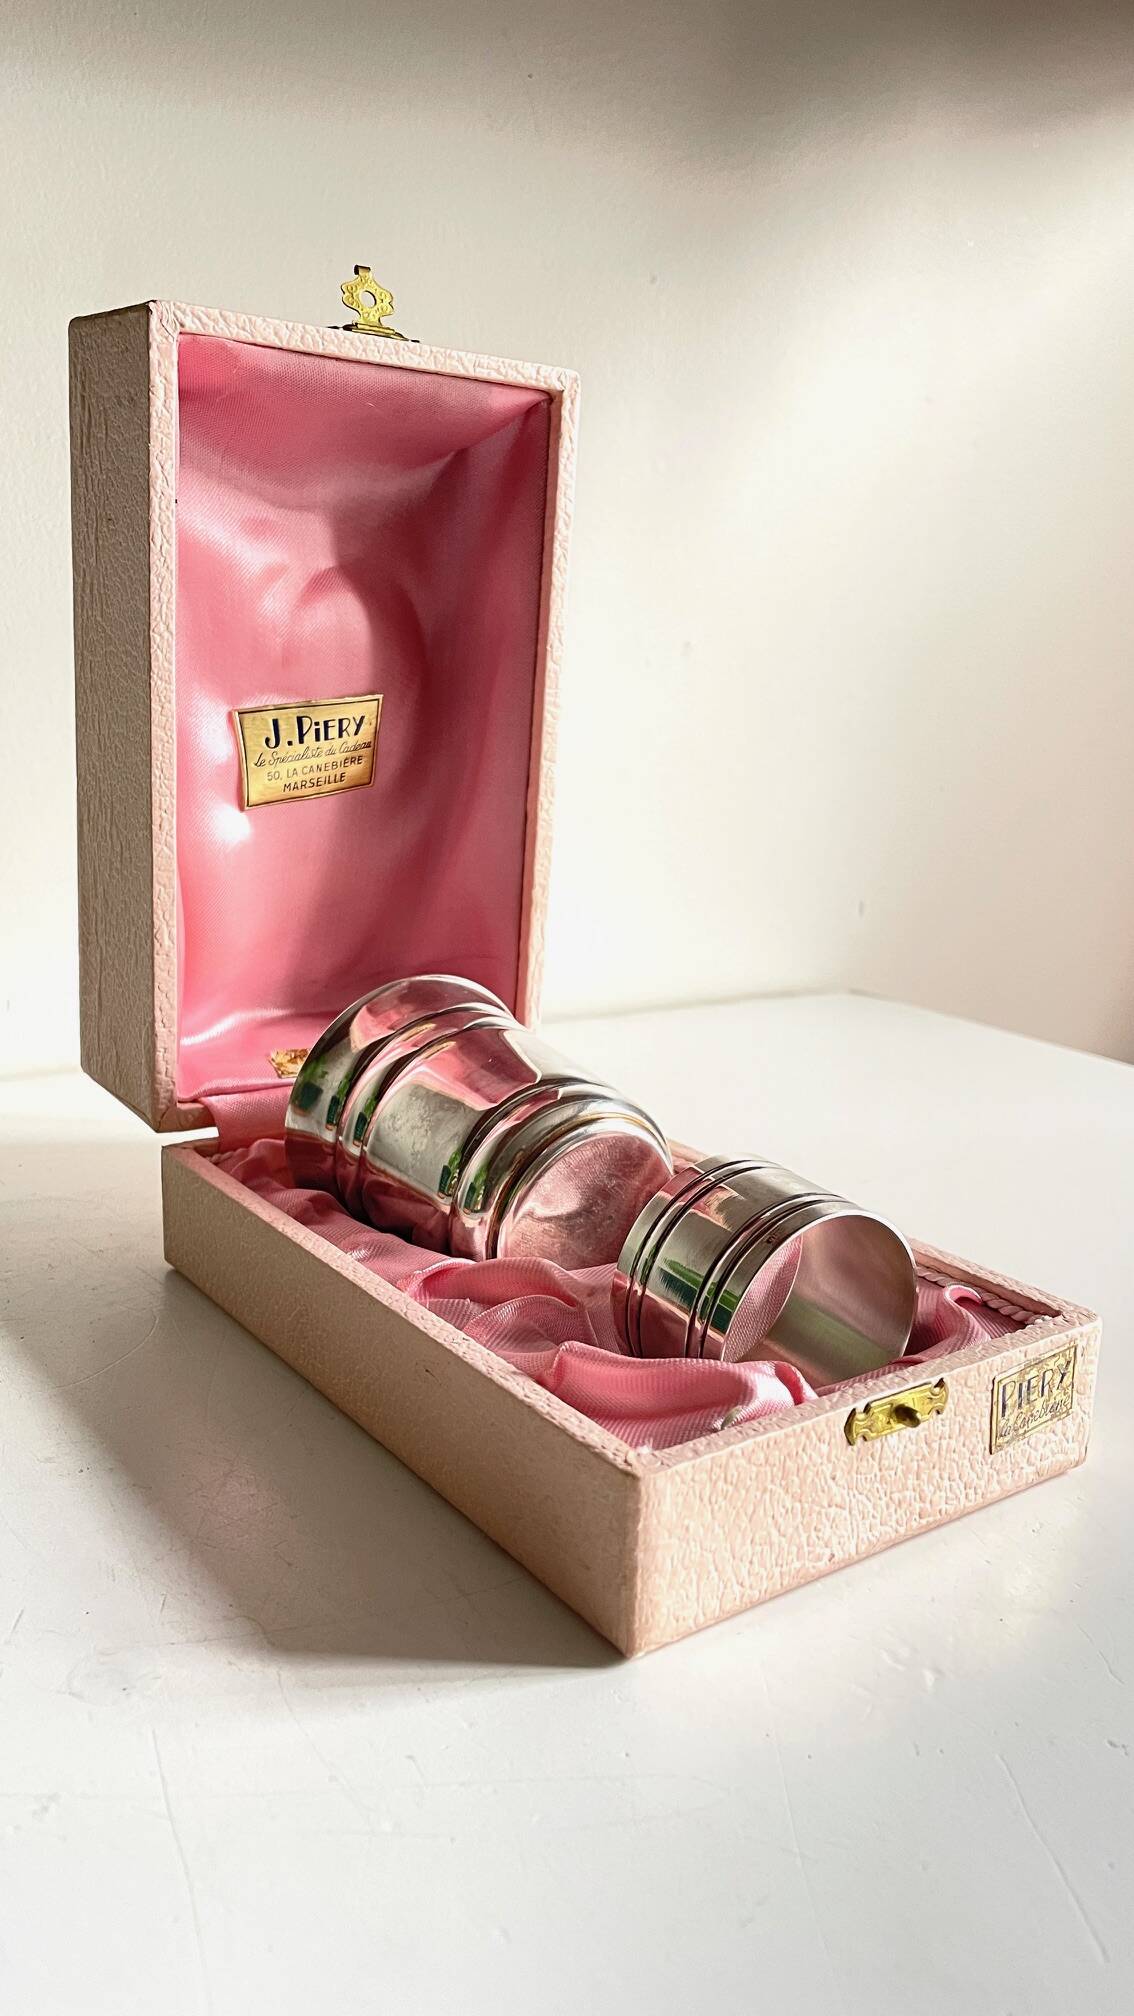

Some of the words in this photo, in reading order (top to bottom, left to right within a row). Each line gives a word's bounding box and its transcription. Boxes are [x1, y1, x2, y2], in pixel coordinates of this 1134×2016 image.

[268, 745, 323, 769] Spécialiste
[324, 746, 337, 756] du
[282, 772, 346, 793] MARSEILLE
[286, 767, 299, 779] LA
